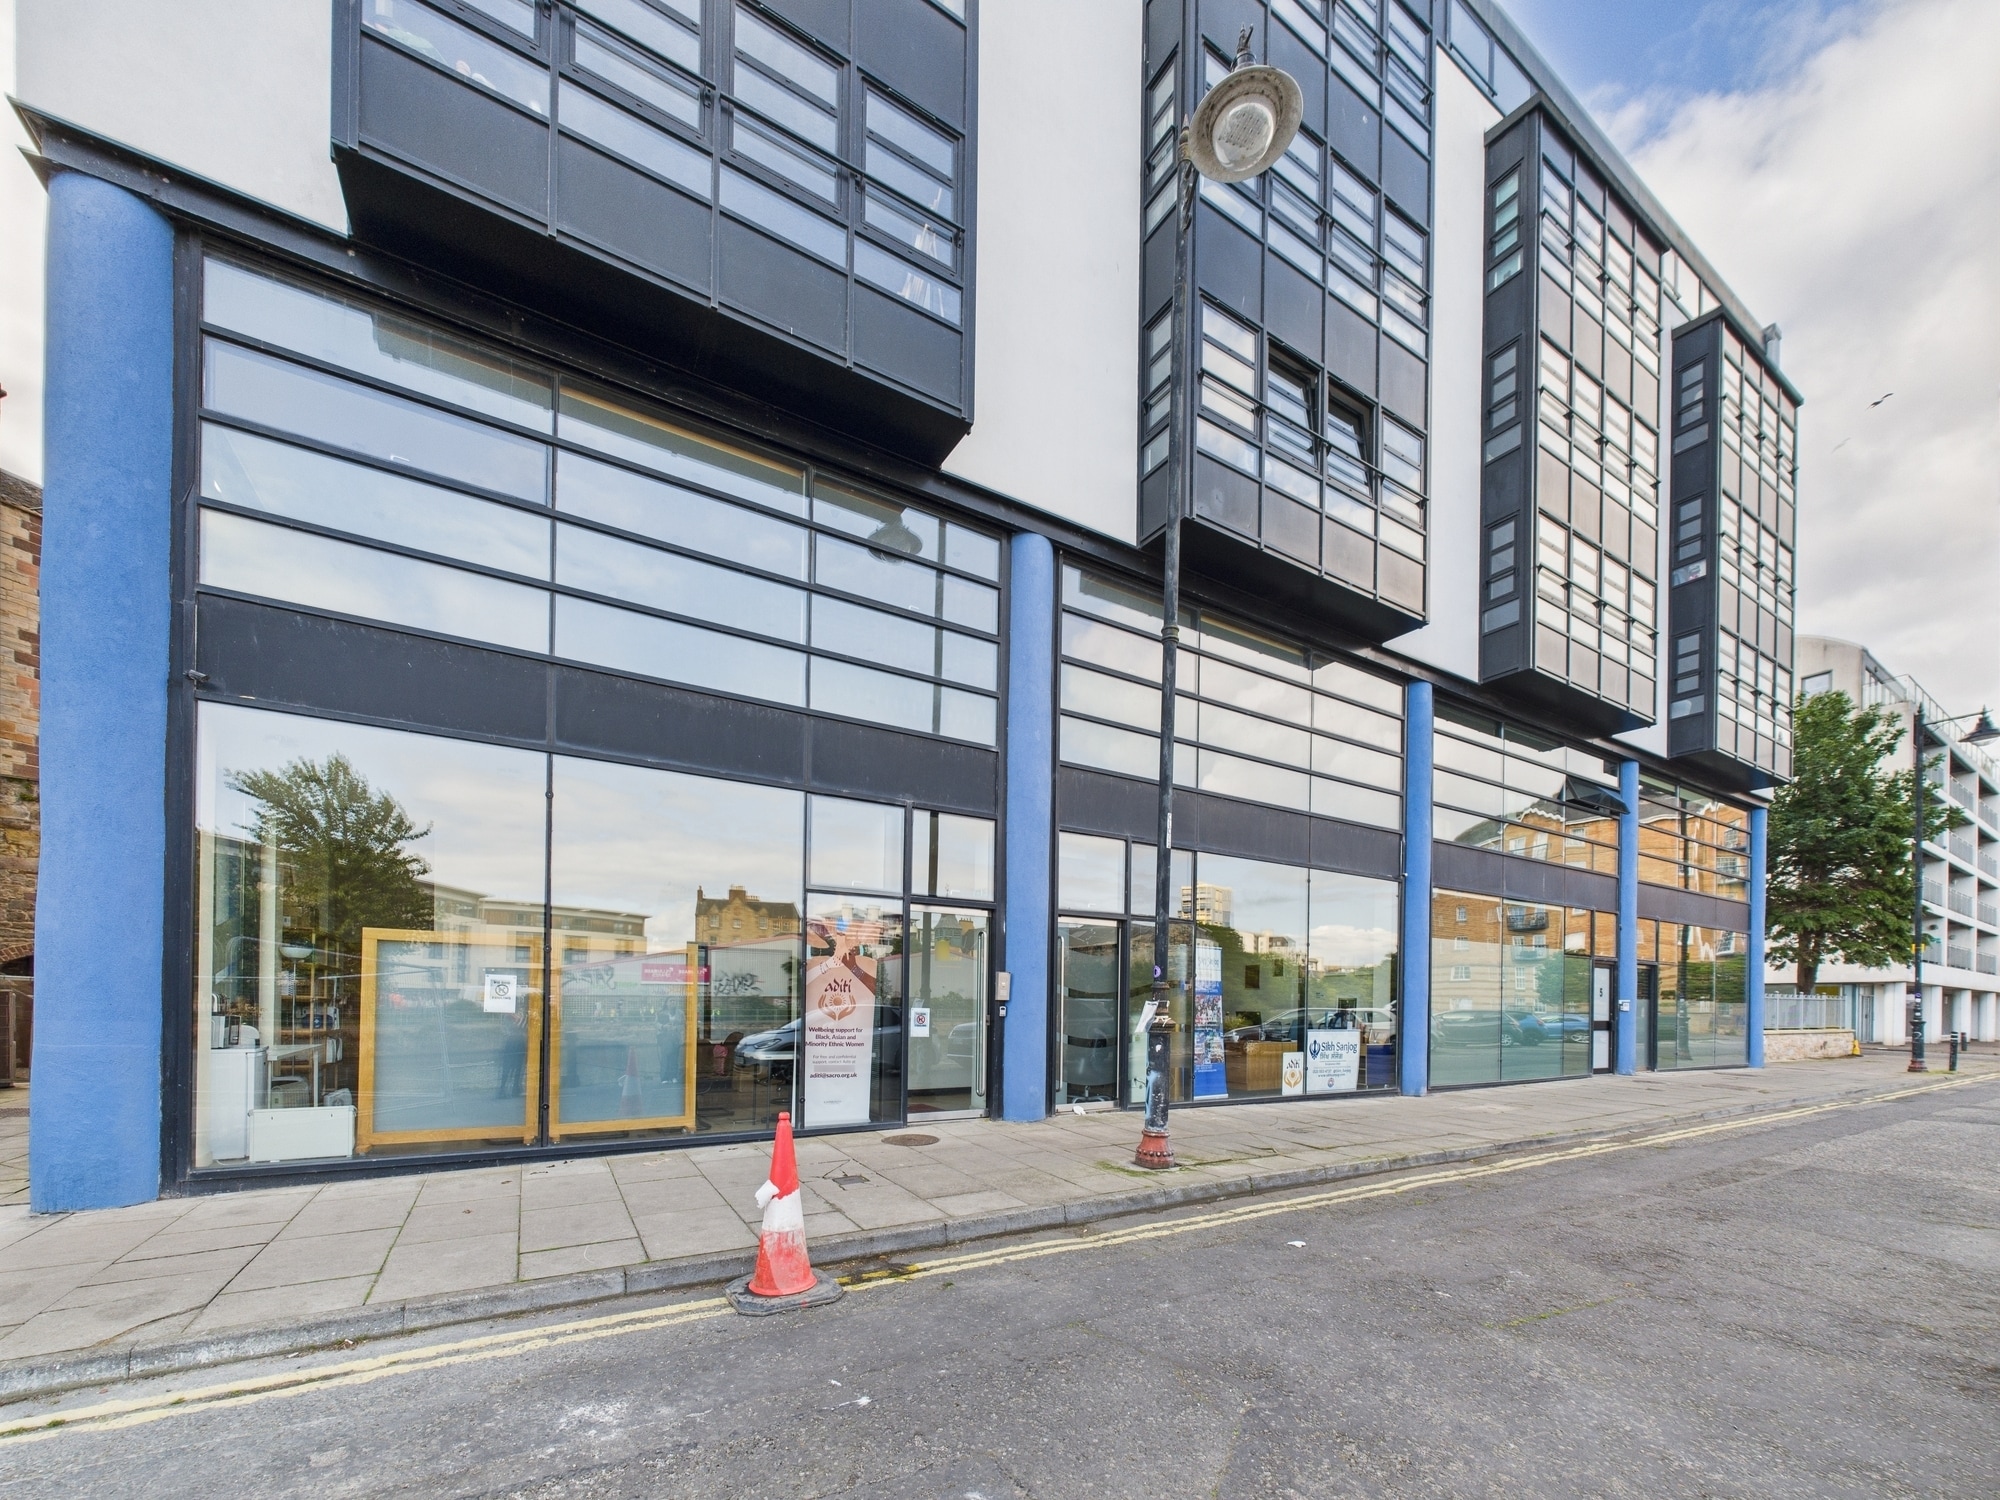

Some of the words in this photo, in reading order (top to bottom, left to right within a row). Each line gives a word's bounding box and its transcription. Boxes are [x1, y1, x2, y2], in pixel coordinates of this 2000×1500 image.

[824, 978, 852, 993] aditi
[1321, 1041, 1335, 1052] Sikh
[1335, 1041, 1358, 1054] Sanjog
